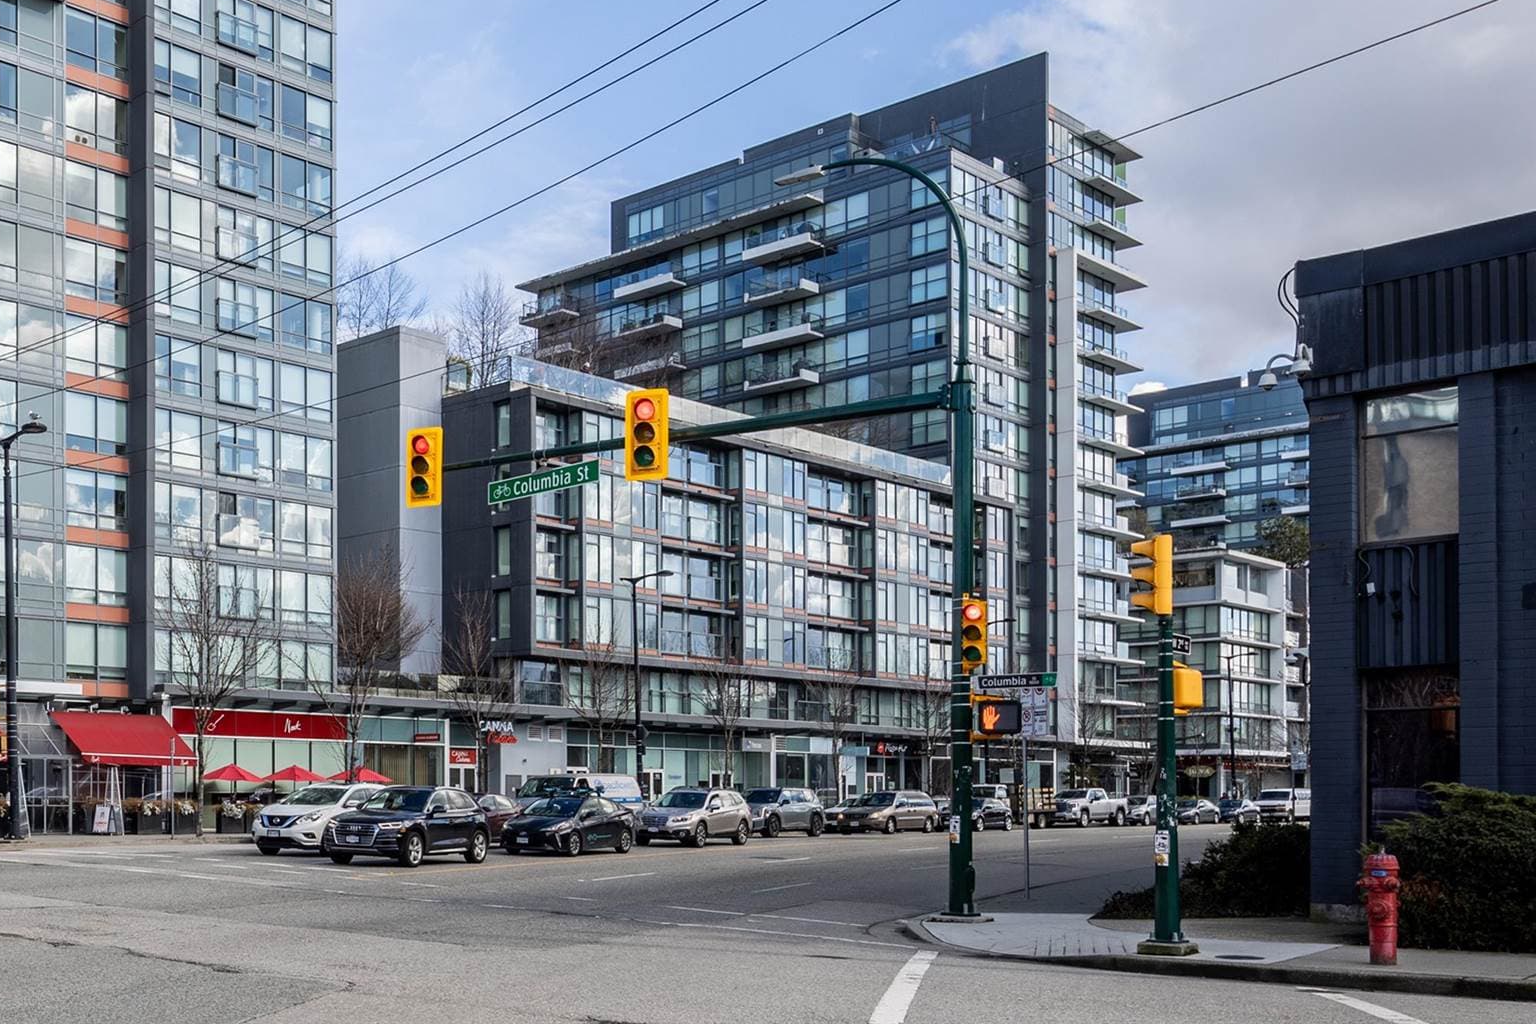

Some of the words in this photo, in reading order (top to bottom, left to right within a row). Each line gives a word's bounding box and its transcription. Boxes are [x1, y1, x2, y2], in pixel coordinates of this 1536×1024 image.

[513, 470, 571, 495] Columbia
[577, 465, 589, 482] St
[981, 676, 1027, 687] Columbia
